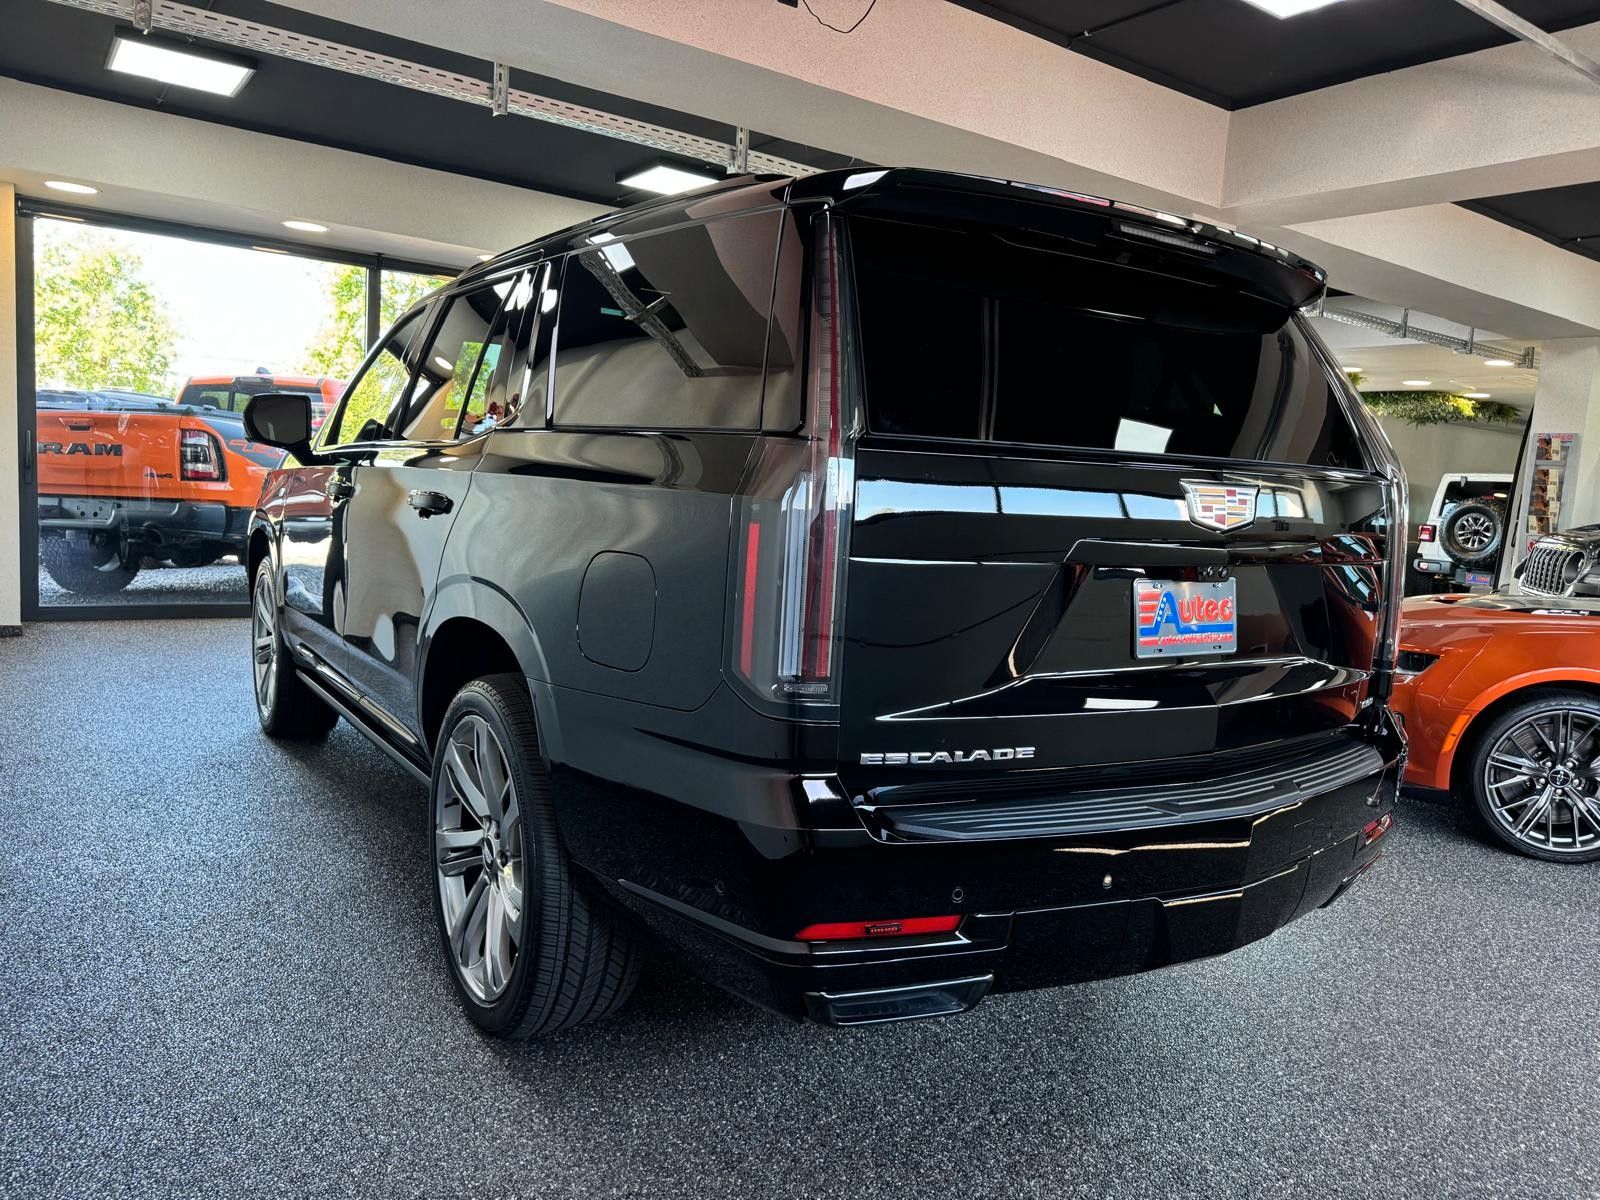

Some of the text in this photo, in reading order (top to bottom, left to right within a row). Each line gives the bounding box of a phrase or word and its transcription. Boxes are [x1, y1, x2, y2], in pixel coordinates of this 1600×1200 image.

[37, 441, 123, 456] RAM
[1152, 590, 1234, 635] Autec
[859, 746, 1036, 765] ESCALADE
